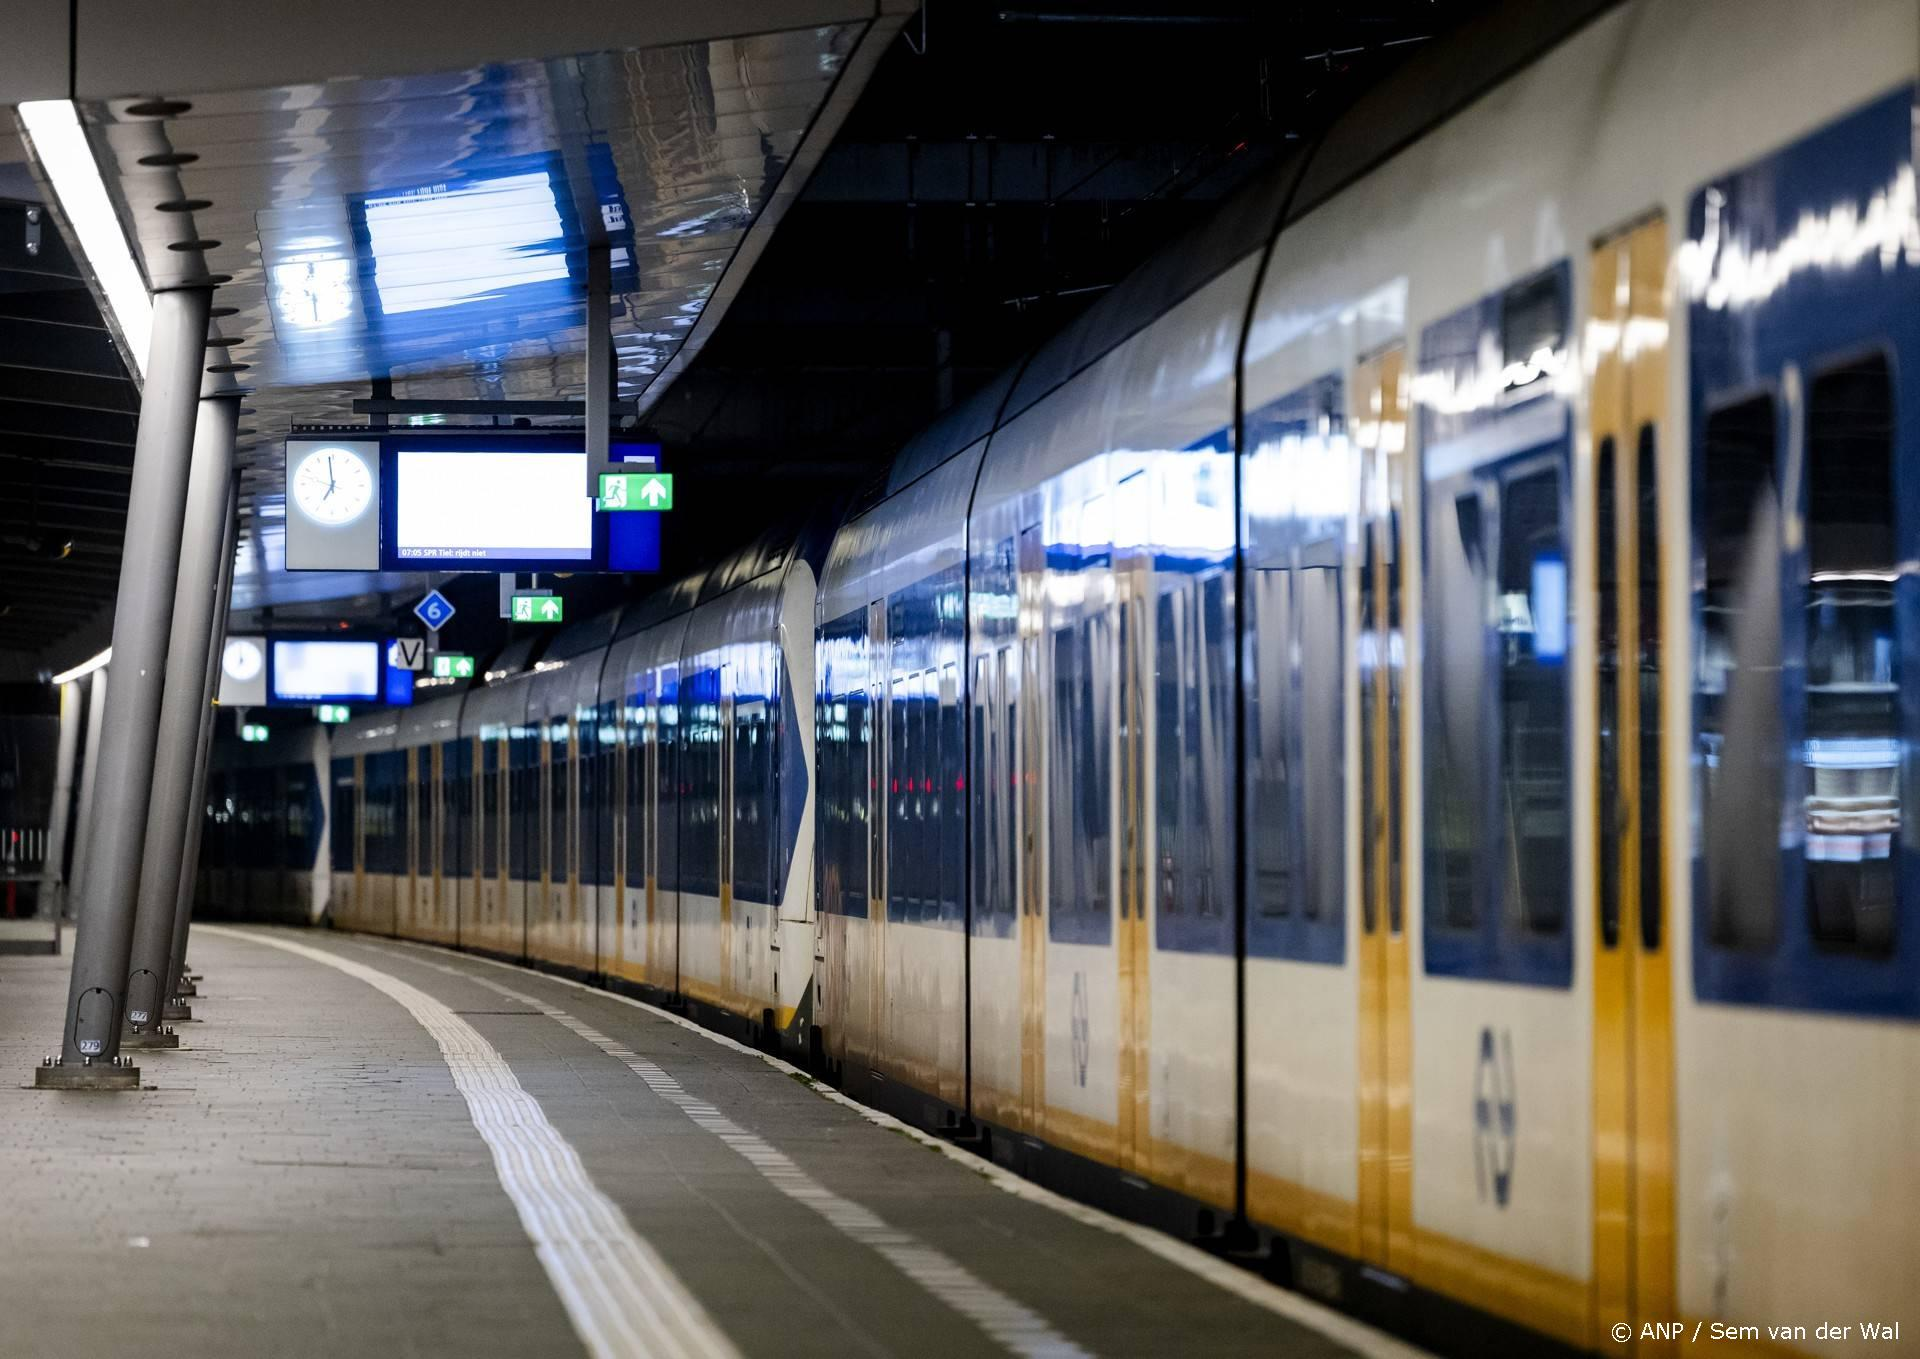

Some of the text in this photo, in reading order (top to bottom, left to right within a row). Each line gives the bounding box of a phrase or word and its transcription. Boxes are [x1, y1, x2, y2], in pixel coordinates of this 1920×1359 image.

[402, 549, 486, 559] 07:05 SPR Tiel: rijdt niet
[427, 602, 441, 620] 6
[400, 641, 421, 667] V
[82, 1040, 100, 1050] 279
